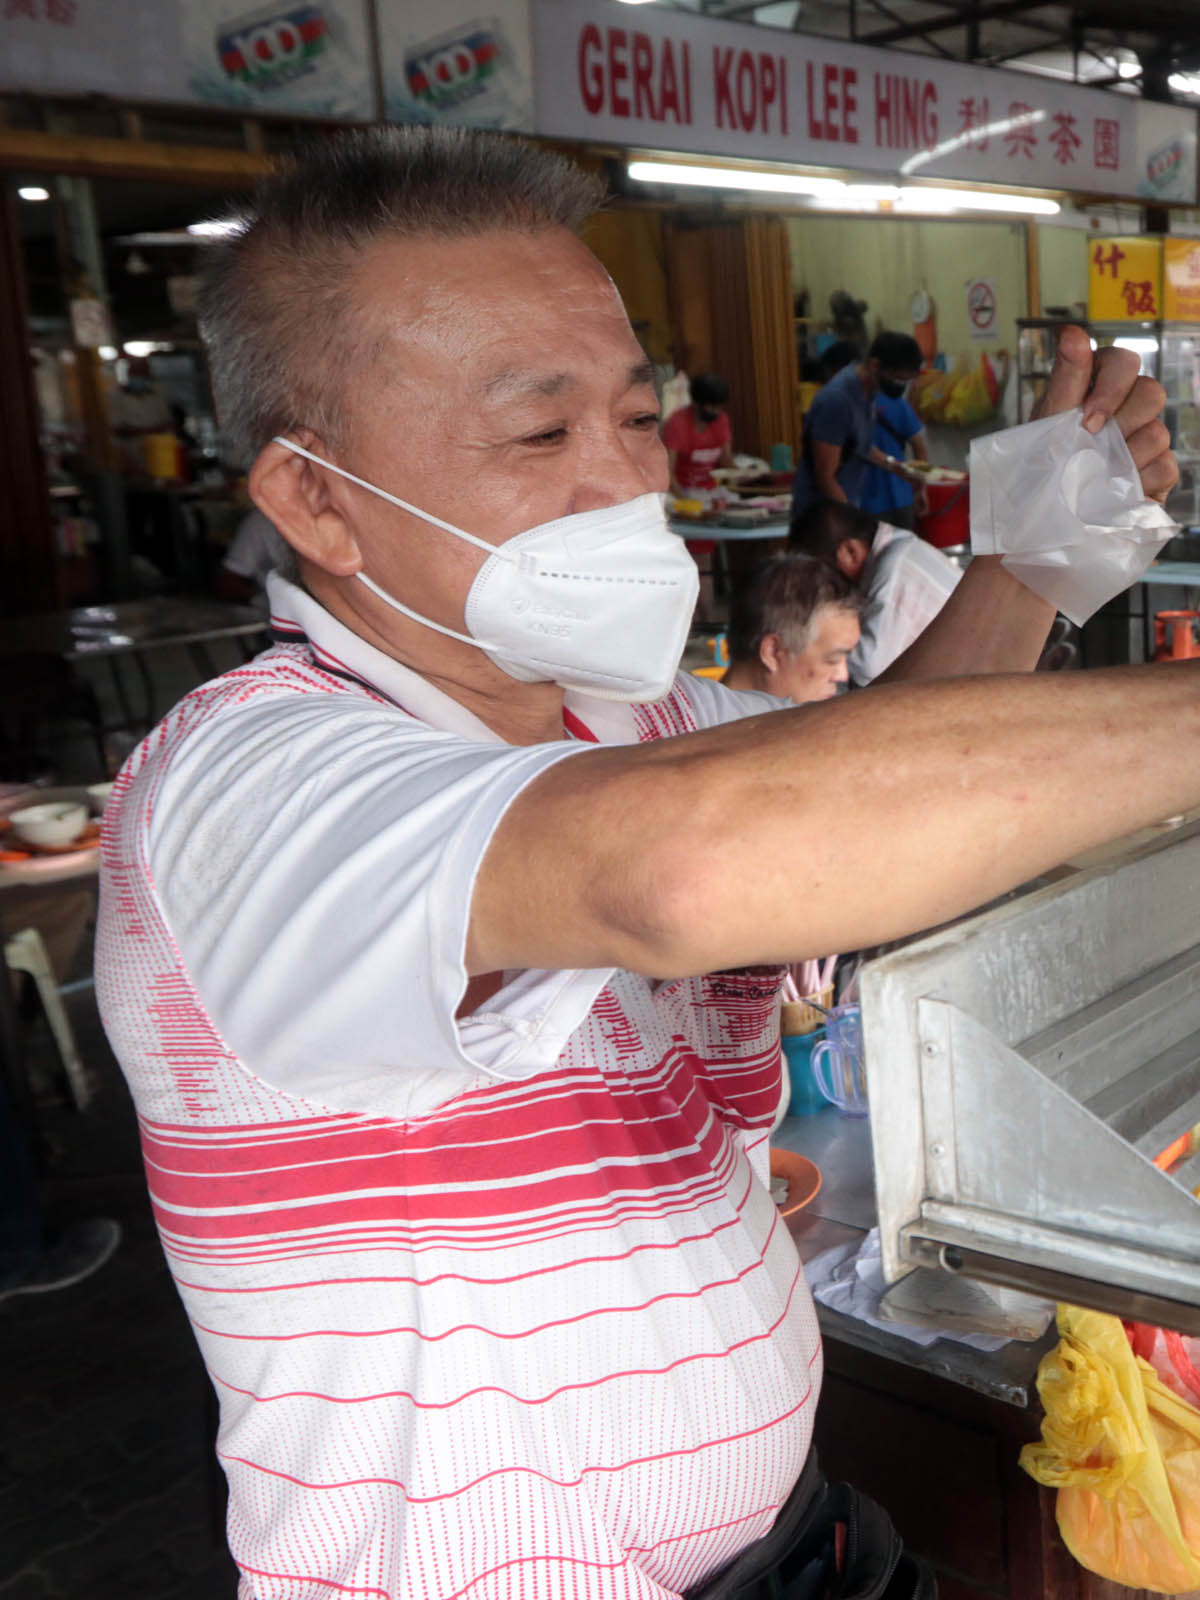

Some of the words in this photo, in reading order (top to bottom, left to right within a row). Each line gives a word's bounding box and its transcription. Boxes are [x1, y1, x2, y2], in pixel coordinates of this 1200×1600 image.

[578, 22, 693, 127] GERAI
[712, 44, 788, 137] KOPI
[806, 60, 859, 144] LEE
[874, 71, 940, 152] HING
